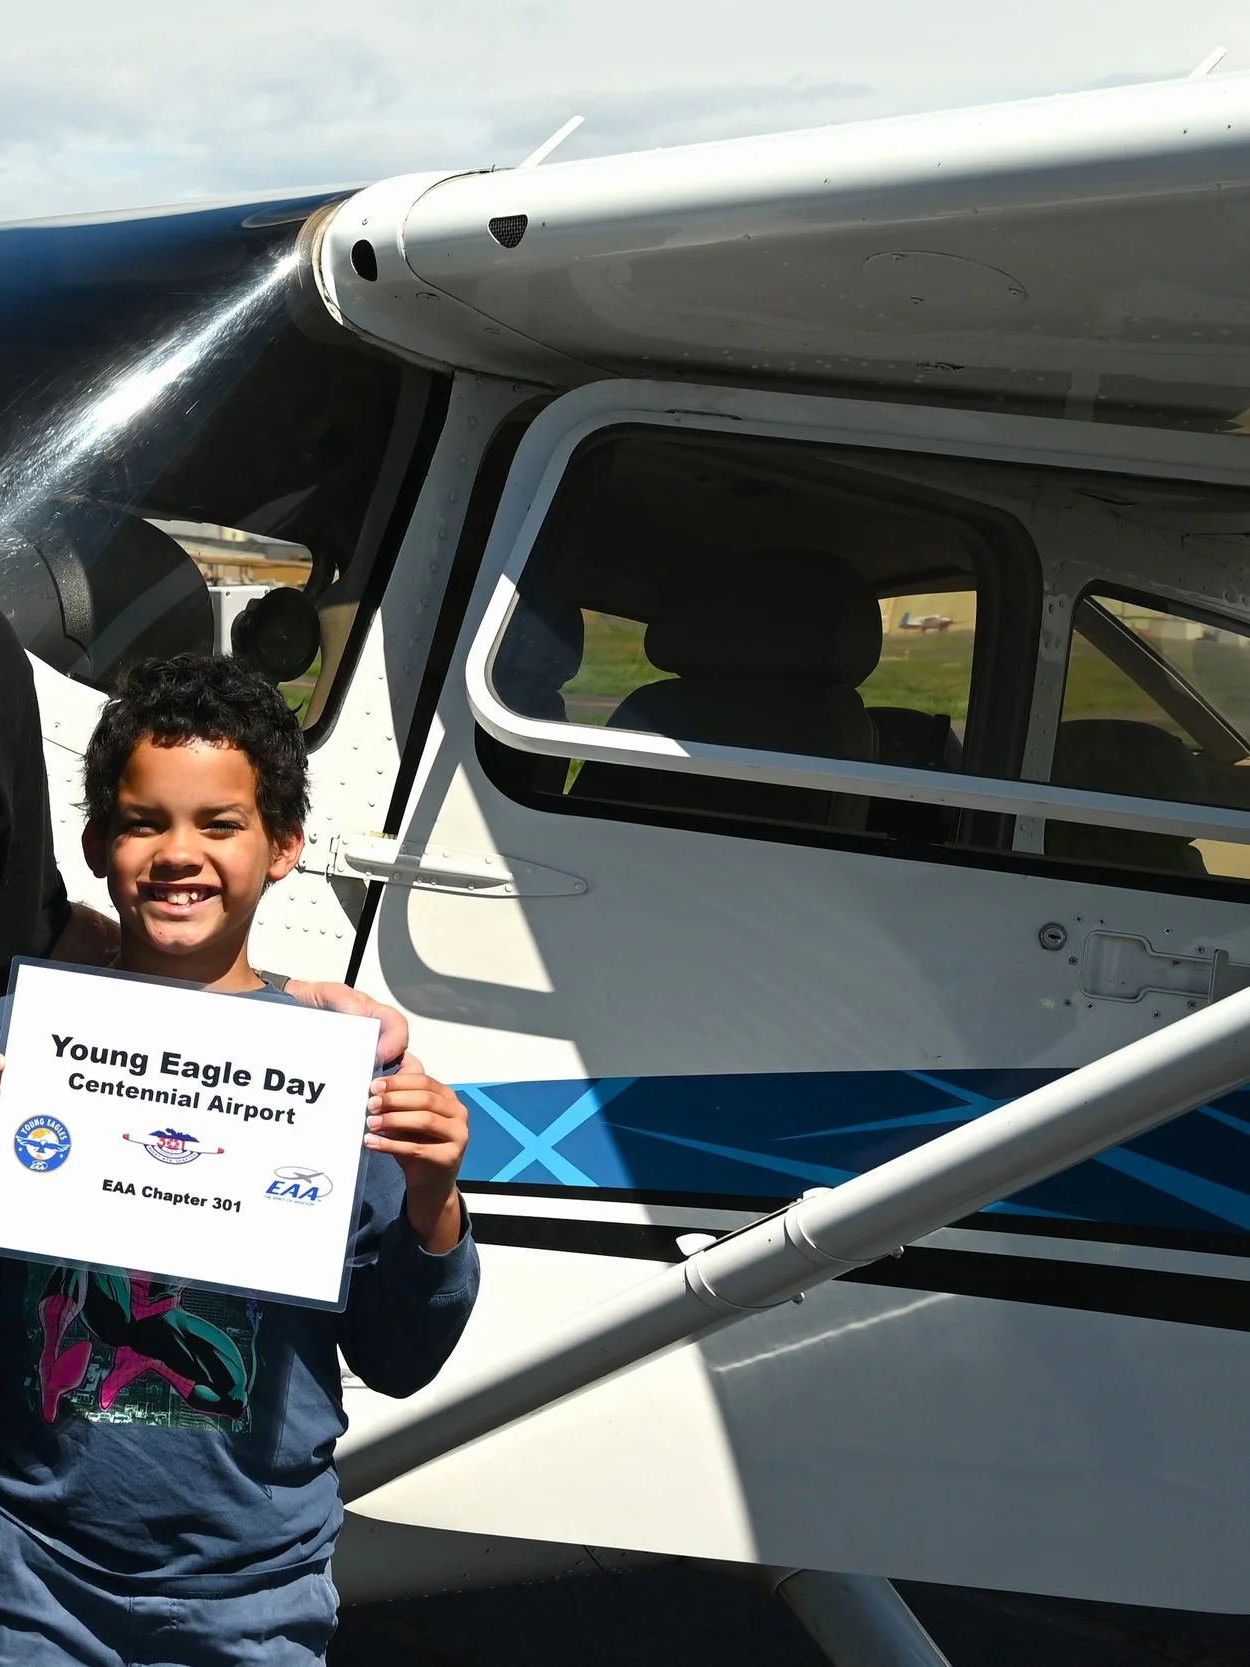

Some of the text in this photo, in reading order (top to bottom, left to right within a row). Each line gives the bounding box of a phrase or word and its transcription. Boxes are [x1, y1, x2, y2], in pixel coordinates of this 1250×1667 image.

[52, 1034, 326, 1104] Young Eagle Day
[68, 1072, 296, 1125] Centennial Airport
[21, 1118, 68, 1141] YOUNG EAGLES
[156, 1136, 186, 1151] 301
[102, 1179, 241, 1213] EAA Chapter 301
[265, 1180, 319, 1202] EAA
